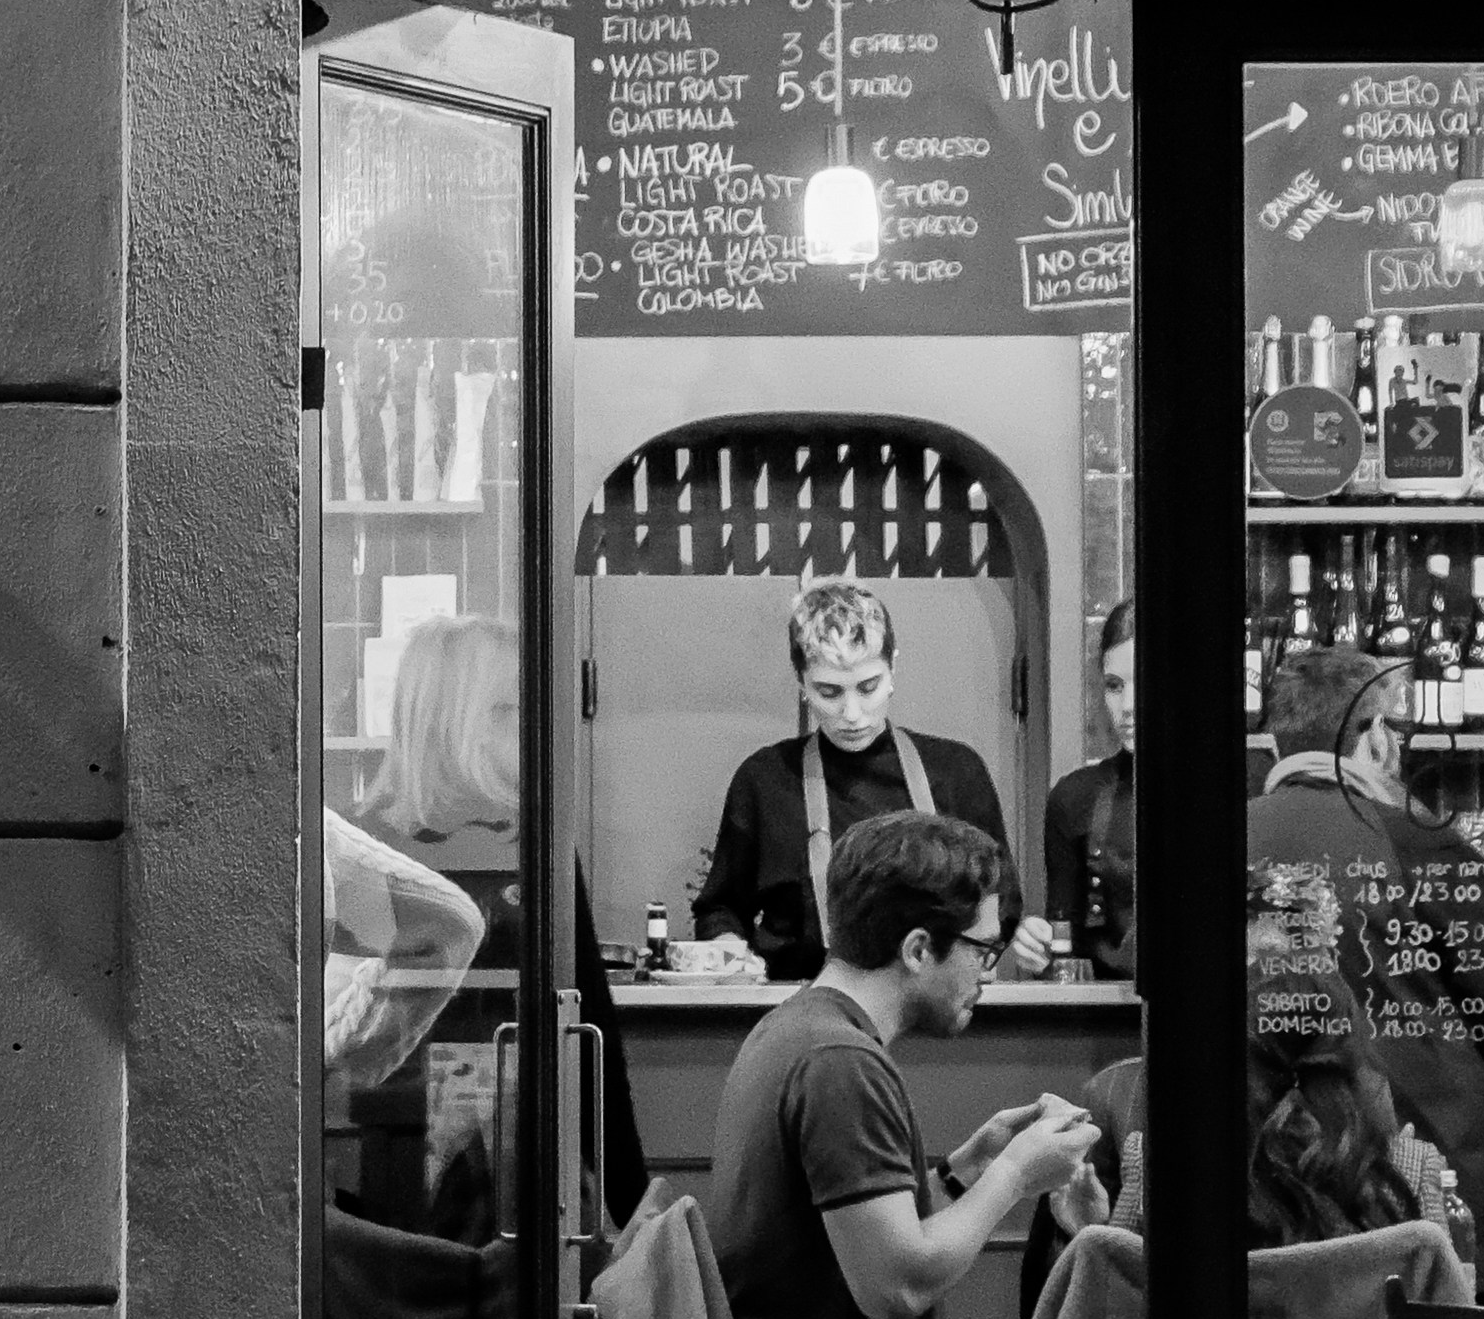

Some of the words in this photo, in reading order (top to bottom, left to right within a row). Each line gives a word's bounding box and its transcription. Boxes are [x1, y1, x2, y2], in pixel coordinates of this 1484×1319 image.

[608, 48, 719, 79] WASHED
[610, 79, 676, 109] LIGHT
[680, 74, 750, 103] ROAST
[777, 71, 805, 112] 5
[608, 106, 739, 138] GUATEMALA
[1073, 110, 1116, 157] e
[1358, 109, 1436, 141] RIBONA
[619, 141, 754, 179] NATURAL
[1358, 142, 1439, 174] GEMMA
[620, 174, 703, 208] LIGHT
[714, 174, 804, 204] ROAST
[617, 207, 699, 237] COSTA
[704, 205, 766, 236] RICA
[726, 235, 818, 264] WASHE
[638, 259, 722, 288] LIGHT
[724, 260, 806, 288] ROAST
[637, 286, 765, 315] COLOMBIA
[1257, 993, 1331, 1014] SABATO
[1258, 1017, 1352, 1036] DOMENICA
